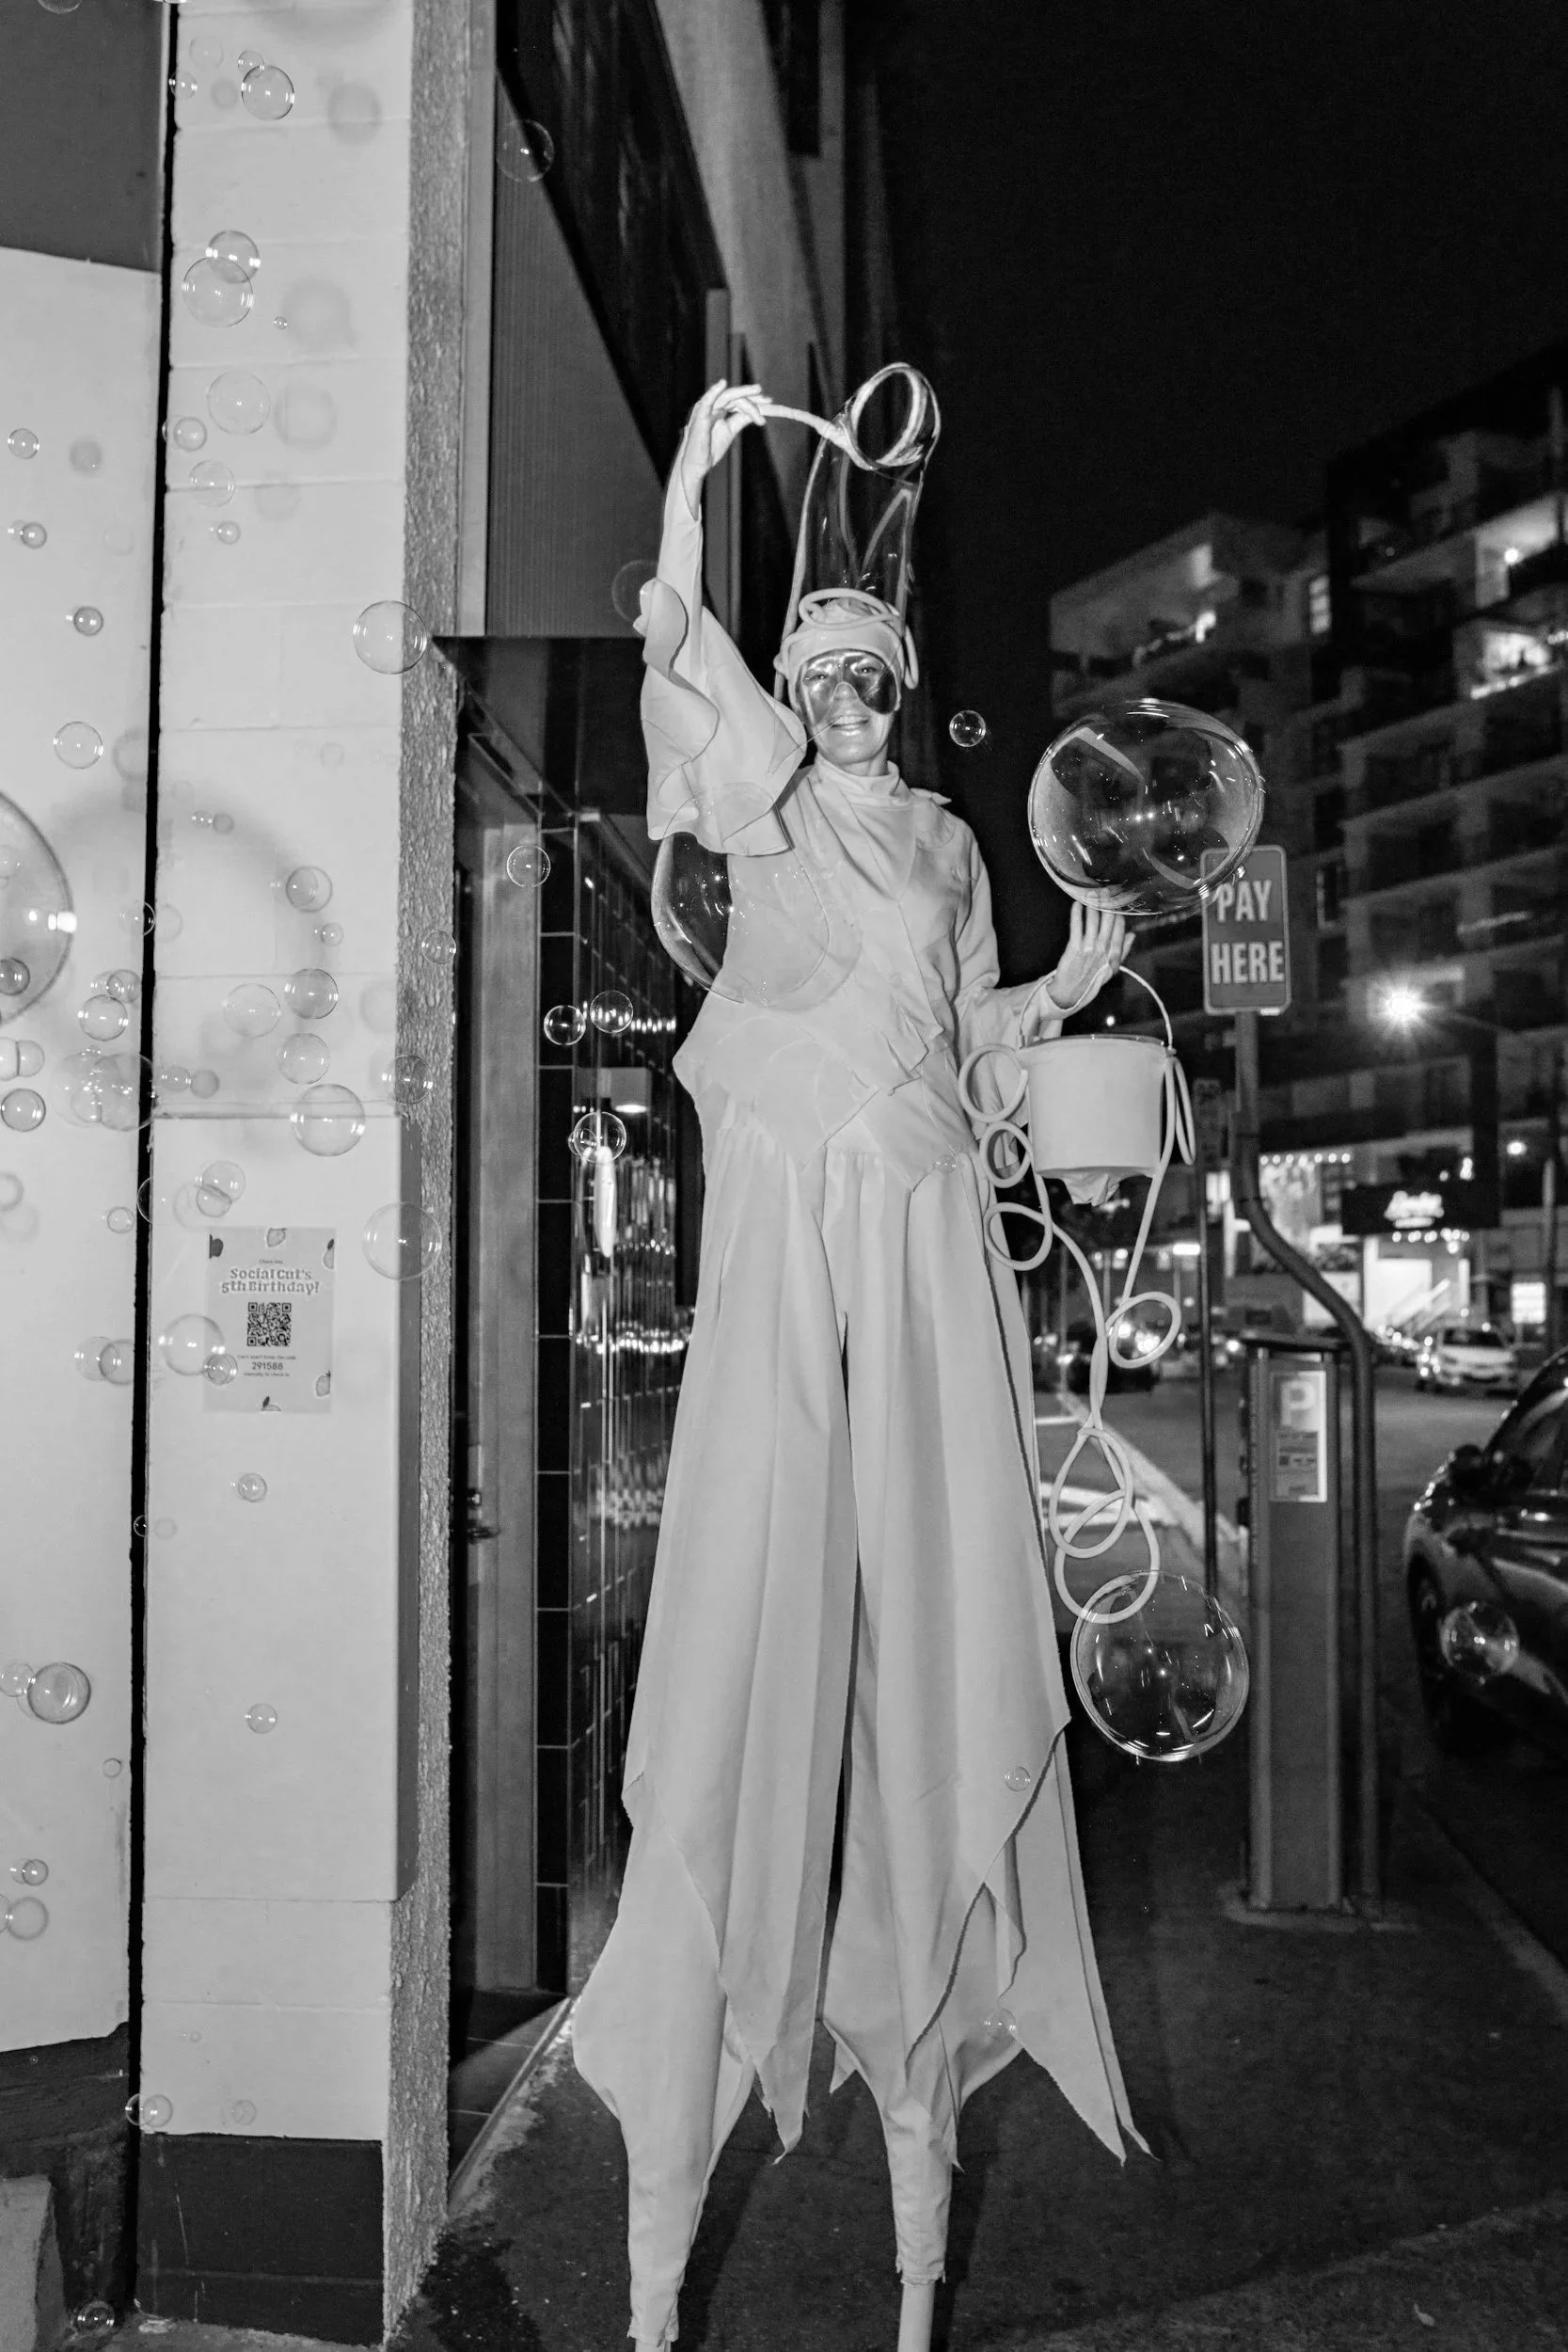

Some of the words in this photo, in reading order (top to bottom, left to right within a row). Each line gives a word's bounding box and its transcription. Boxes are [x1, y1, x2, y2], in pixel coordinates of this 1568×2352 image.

[1216, 879, 1272, 923] PAY
[1211, 941, 1285, 985] HERE
[221, 1280, 246, 1294] 5th
[248, 1280, 320, 1295] Birthday!
[230, 1267, 275, 1280] Social
[277, 1268, 312, 1280] Cut's
[251, 1361, 284, 1371] 291588
[1280, 1379, 1316, 1425] P
